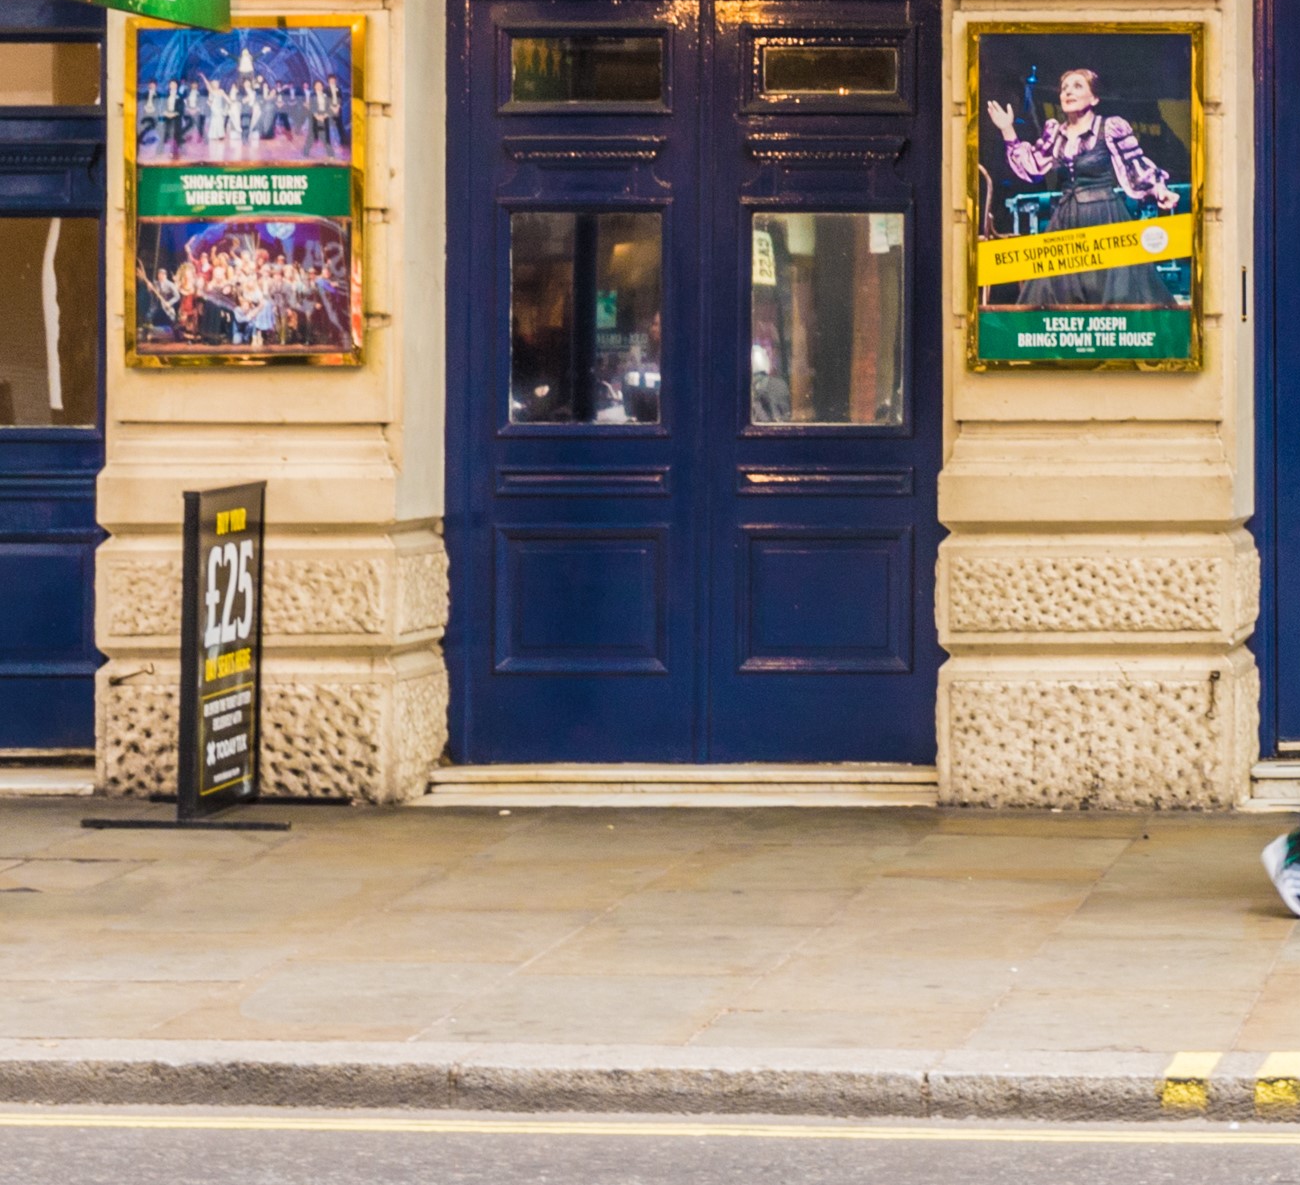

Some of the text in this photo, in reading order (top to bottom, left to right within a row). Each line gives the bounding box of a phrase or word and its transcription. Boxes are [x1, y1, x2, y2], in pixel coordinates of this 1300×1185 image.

[270, 174, 308, 190] TURNS
[185, 190, 247, 205] WHEREVER
[248, 190, 271, 205] YOU
[995, 233, 1139, 266] BEST SUPPORTING ACTRESS
[1032, 254, 1104, 274] IN A MUSICAL
[1086, 317, 1127, 331] JOSEPH
[1018, 333, 1057, 347] BRINGS
[1059, 332, 1092, 347] DOWN
[1094, 332, 1116, 346] THE
[204, 539, 253, 648] £25
